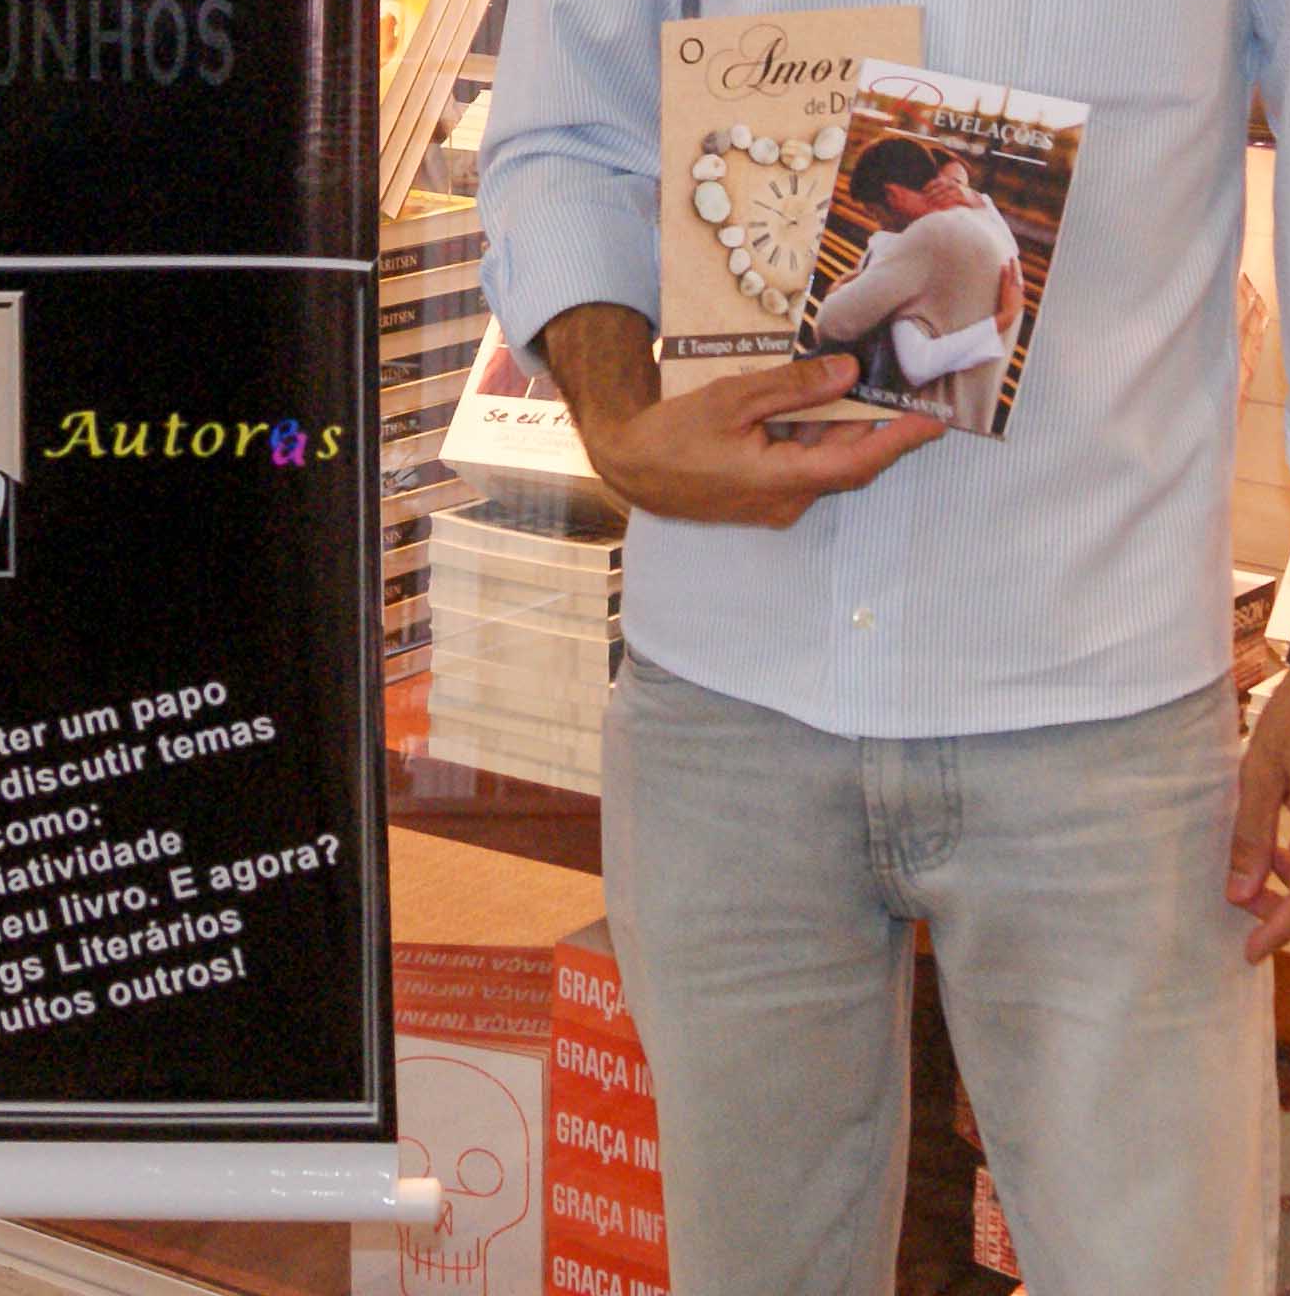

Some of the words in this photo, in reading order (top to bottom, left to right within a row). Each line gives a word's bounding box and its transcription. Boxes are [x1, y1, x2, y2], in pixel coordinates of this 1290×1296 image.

[679, 36, 705, 66] O
[714, 25, 857, 98] Amor
[803, 95, 828, 117] de
[690, 339, 734, 356] Tempo
[736, 339, 754, 354] de
[755, 336, 791, 352] Viver
[483, 407, 509, 424] Se
[517, 409, 549, 425] eu
[60, 707, 118, 744] um
[130, 678, 228, 732] papo
[157, 713, 277, 764] temas
[59, 876, 160, 932] livro.
[168, 867, 199, 902] E
[208, 832, 341, 902] agora?
[55, 907, 245, 977] Literários
[108, 947, 248, 1012] outros!
[556, 1037, 629, 1092] GRAÇA
[555, 1110, 629, 1165] GRAÇA
[552, 1183, 624, 1237] GRAÇA
